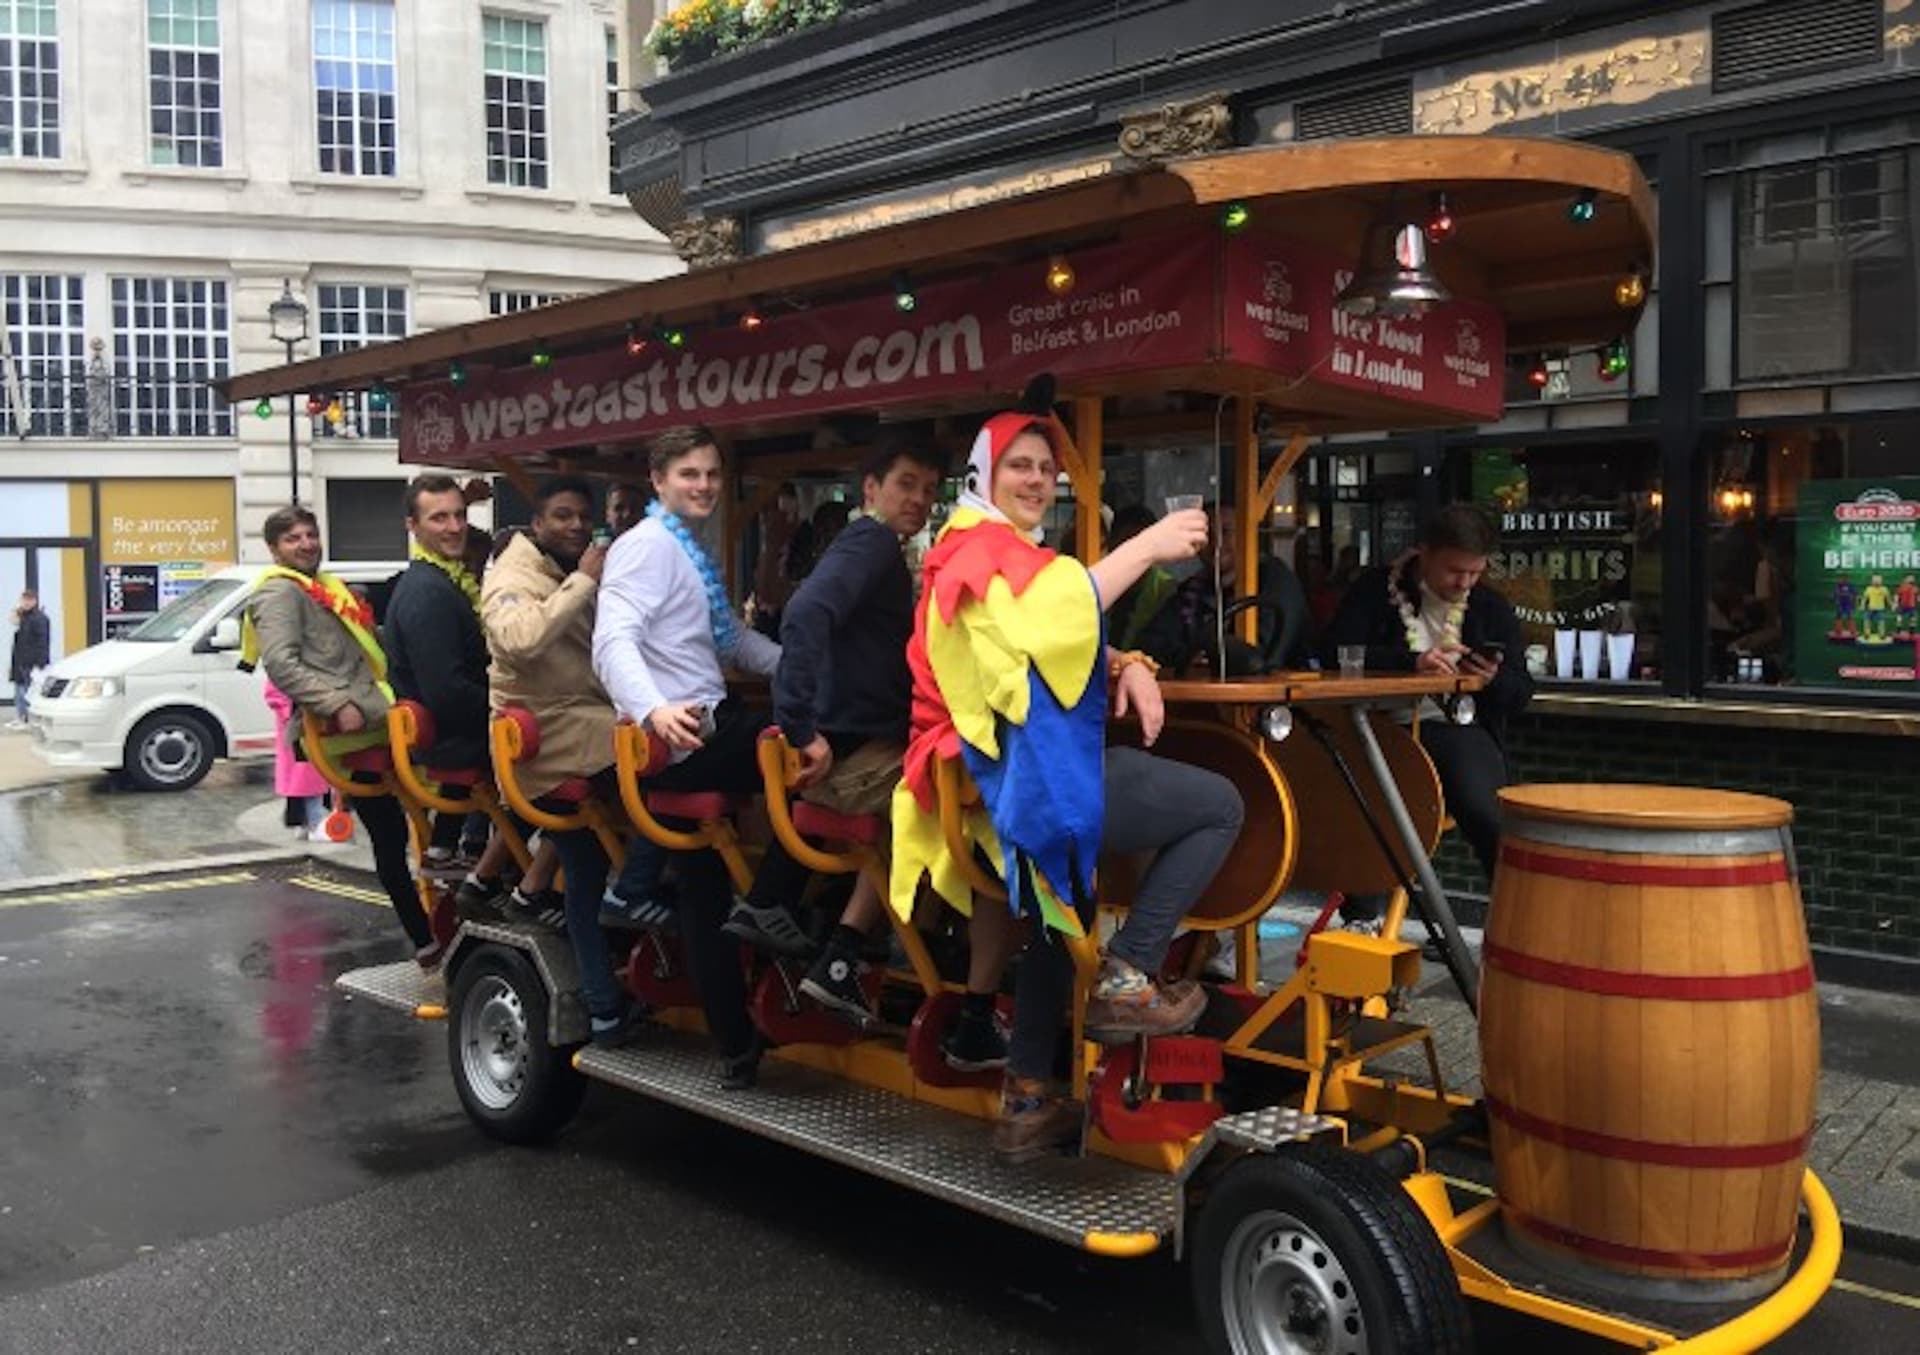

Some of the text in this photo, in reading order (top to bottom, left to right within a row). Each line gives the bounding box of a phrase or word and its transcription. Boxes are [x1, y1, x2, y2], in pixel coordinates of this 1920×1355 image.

[1009, 285, 1141, 326] Great craic in
[1011, 310, 1181, 354] Belfast & London
[1331, 342, 1424, 392] in London
[112, 517, 219, 535] Be amongst
[1503, 510, 1612, 531] BRITISH
[112, 536, 227, 557] the very best
[1488, 550, 1627, 580] SPIRITS
[1823, 550, 1920, 569] BE HERE
